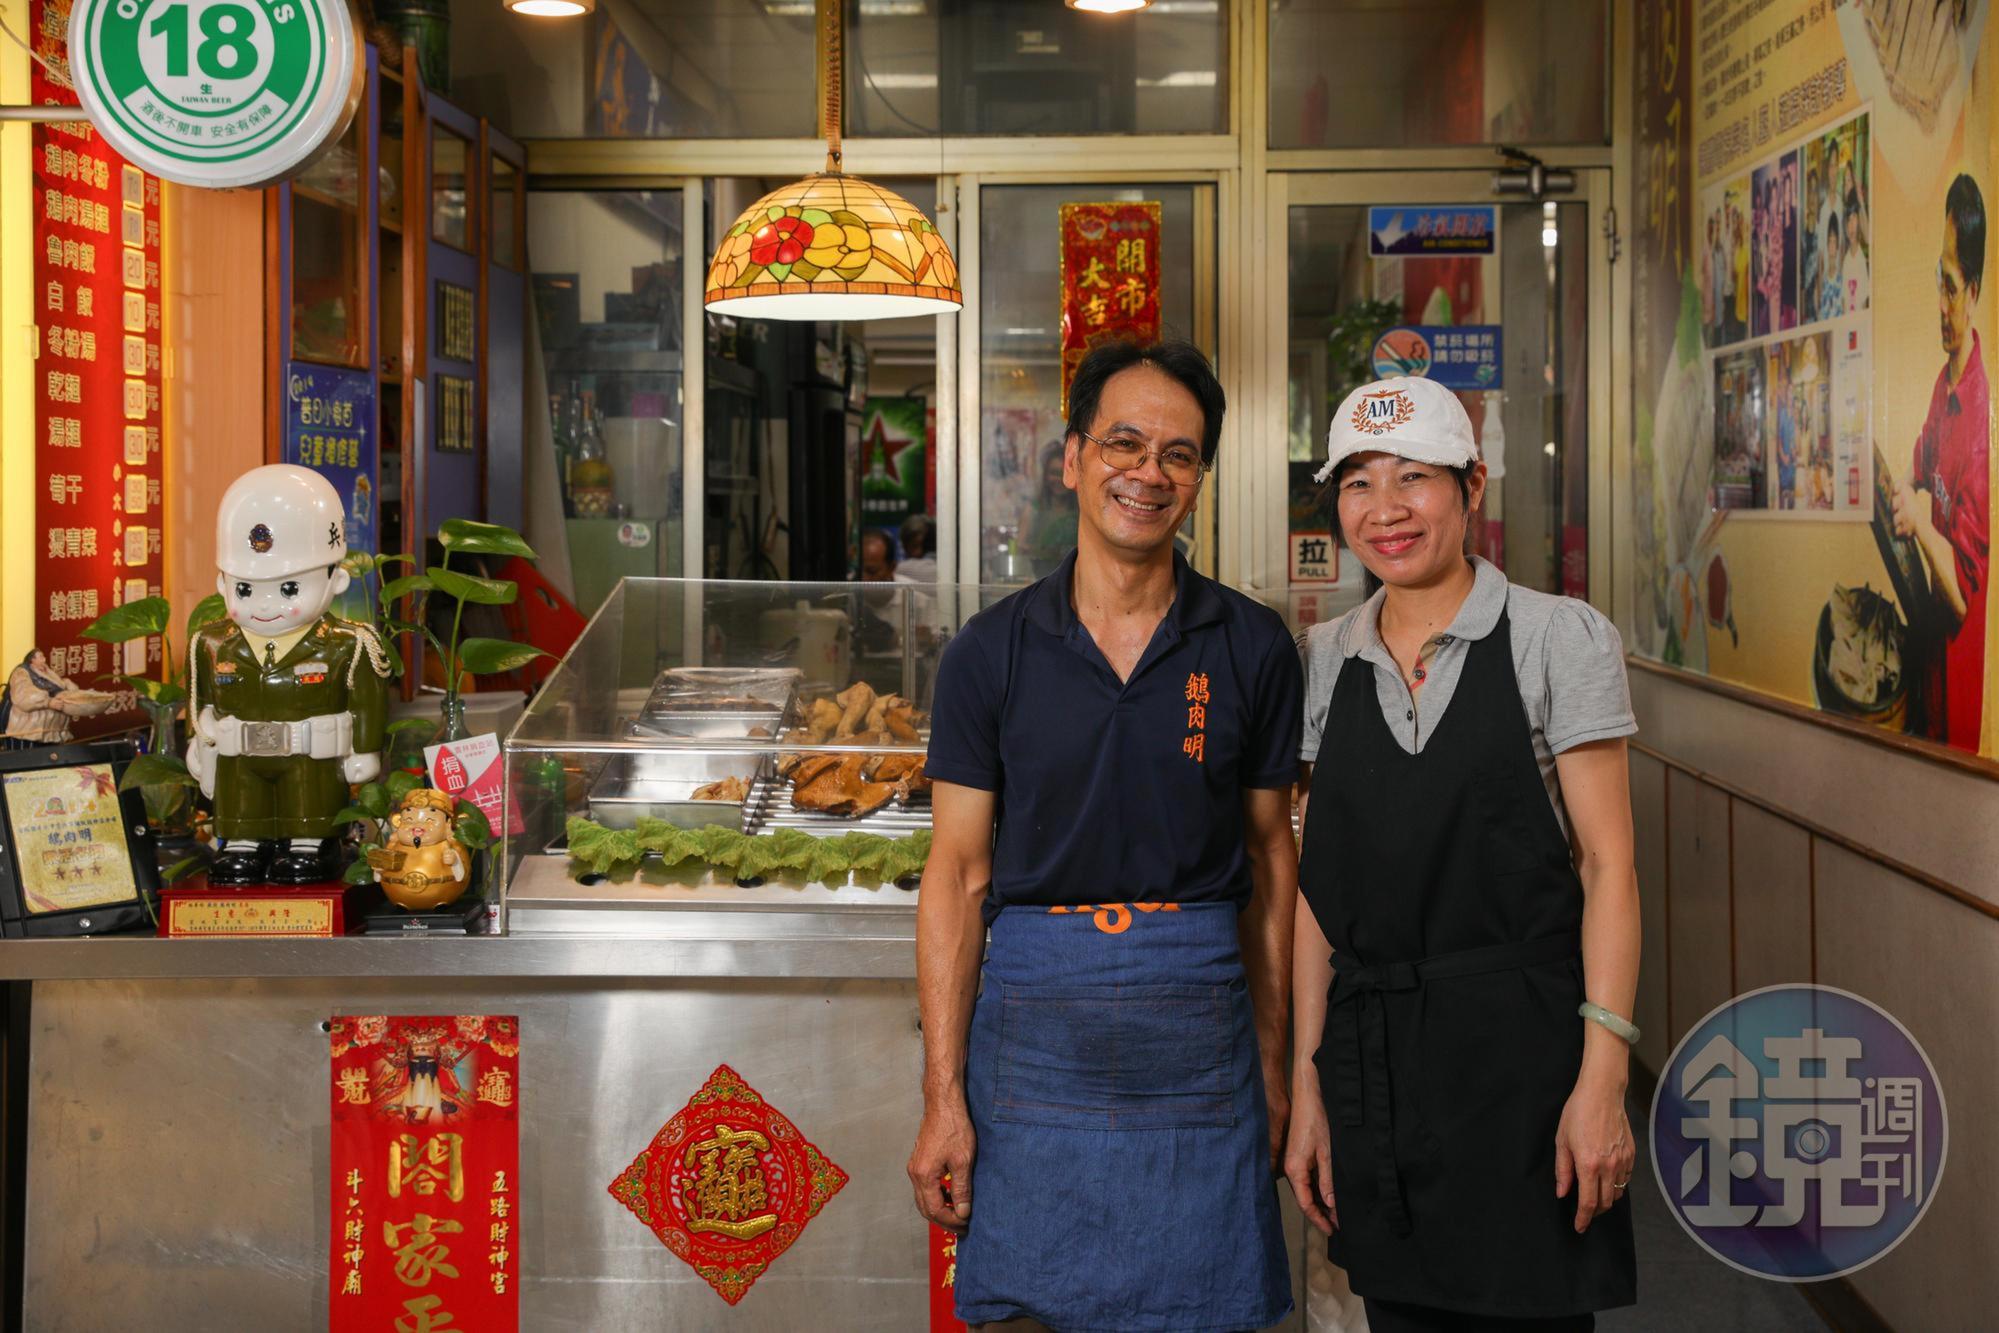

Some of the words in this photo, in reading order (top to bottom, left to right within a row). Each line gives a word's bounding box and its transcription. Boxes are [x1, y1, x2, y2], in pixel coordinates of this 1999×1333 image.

[150, 3, 259, 80] 18
[181, 95, 209, 104] TAIWAN
[211, 96, 232, 105] BEER
[200, 83, 213, 95] 生
[140, 100, 203, 137] 酒後不開車
[210, 103, 274, 138] 安全有保障
[145, 178, 159, 206] 元
[146, 220, 159, 247] 元
[146, 261, 159, 288] 元
[1117, 238, 1146, 317] 開市
[1081, 256, 1111, 325] 大吉
[147, 302, 160, 329] 元
[147, 343, 160, 370] 元
[146, 385, 159, 411] 元
[1366, 399, 1395, 419] AM
[147, 426, 160, 452] 元
[147, 479, 160, 505] 元
[48, 527, 97, 559] 燙青菜
[148, 527, 161, 554] 元
[328, 519, 346, 550] 兵
[1298, 538, 1329, 565] 拉
[1298, 567, 1329, 577] PULL
[1183, 672, 1211, 764] 鵝肉明
[441, 755, 466, 791] 捐血
[341, 1168, 365, 1296] 斗六財神廟
[489, 1170, 512, 1295] 五路財神宮
